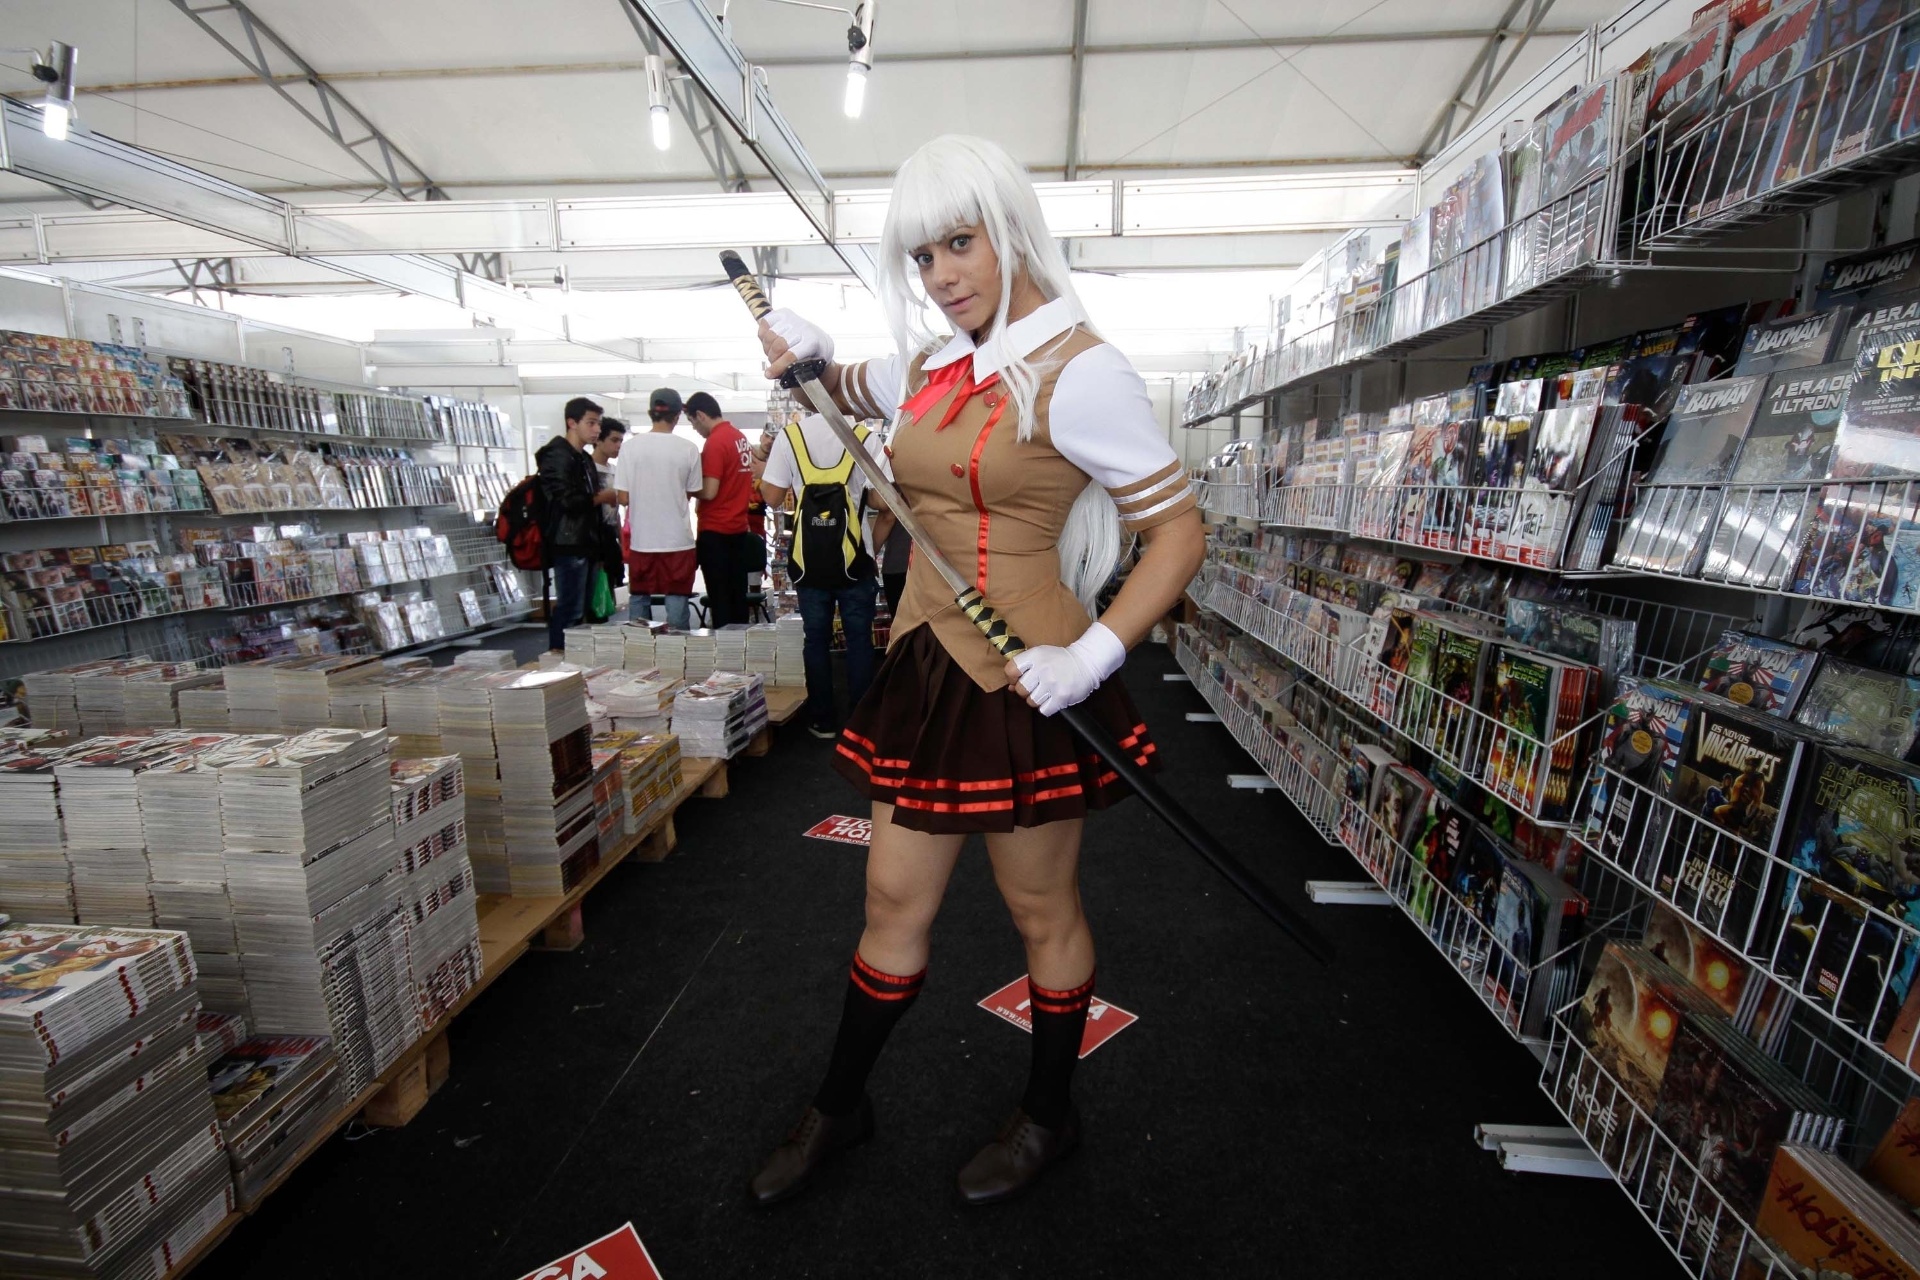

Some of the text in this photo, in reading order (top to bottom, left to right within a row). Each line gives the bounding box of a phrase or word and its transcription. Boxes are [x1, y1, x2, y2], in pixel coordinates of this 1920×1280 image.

[1833, 248, 1917, 290] BATMAN
[1868, 302, 1919, 326] ERA
[1753, 319, 1826, 355] BATMAN
[1786, 376, 1829, 397] ERA
[1682, 382, 1754, 416] BATMAN
[1771, 392, 1843, 416] ULTRON
[1711, 723, 1751, 744] OS NOVOS
[828, 826, 872, 841] HQ
[836, 818, 872, 830] LIG
[532, 1252, 608, 1280] GA
